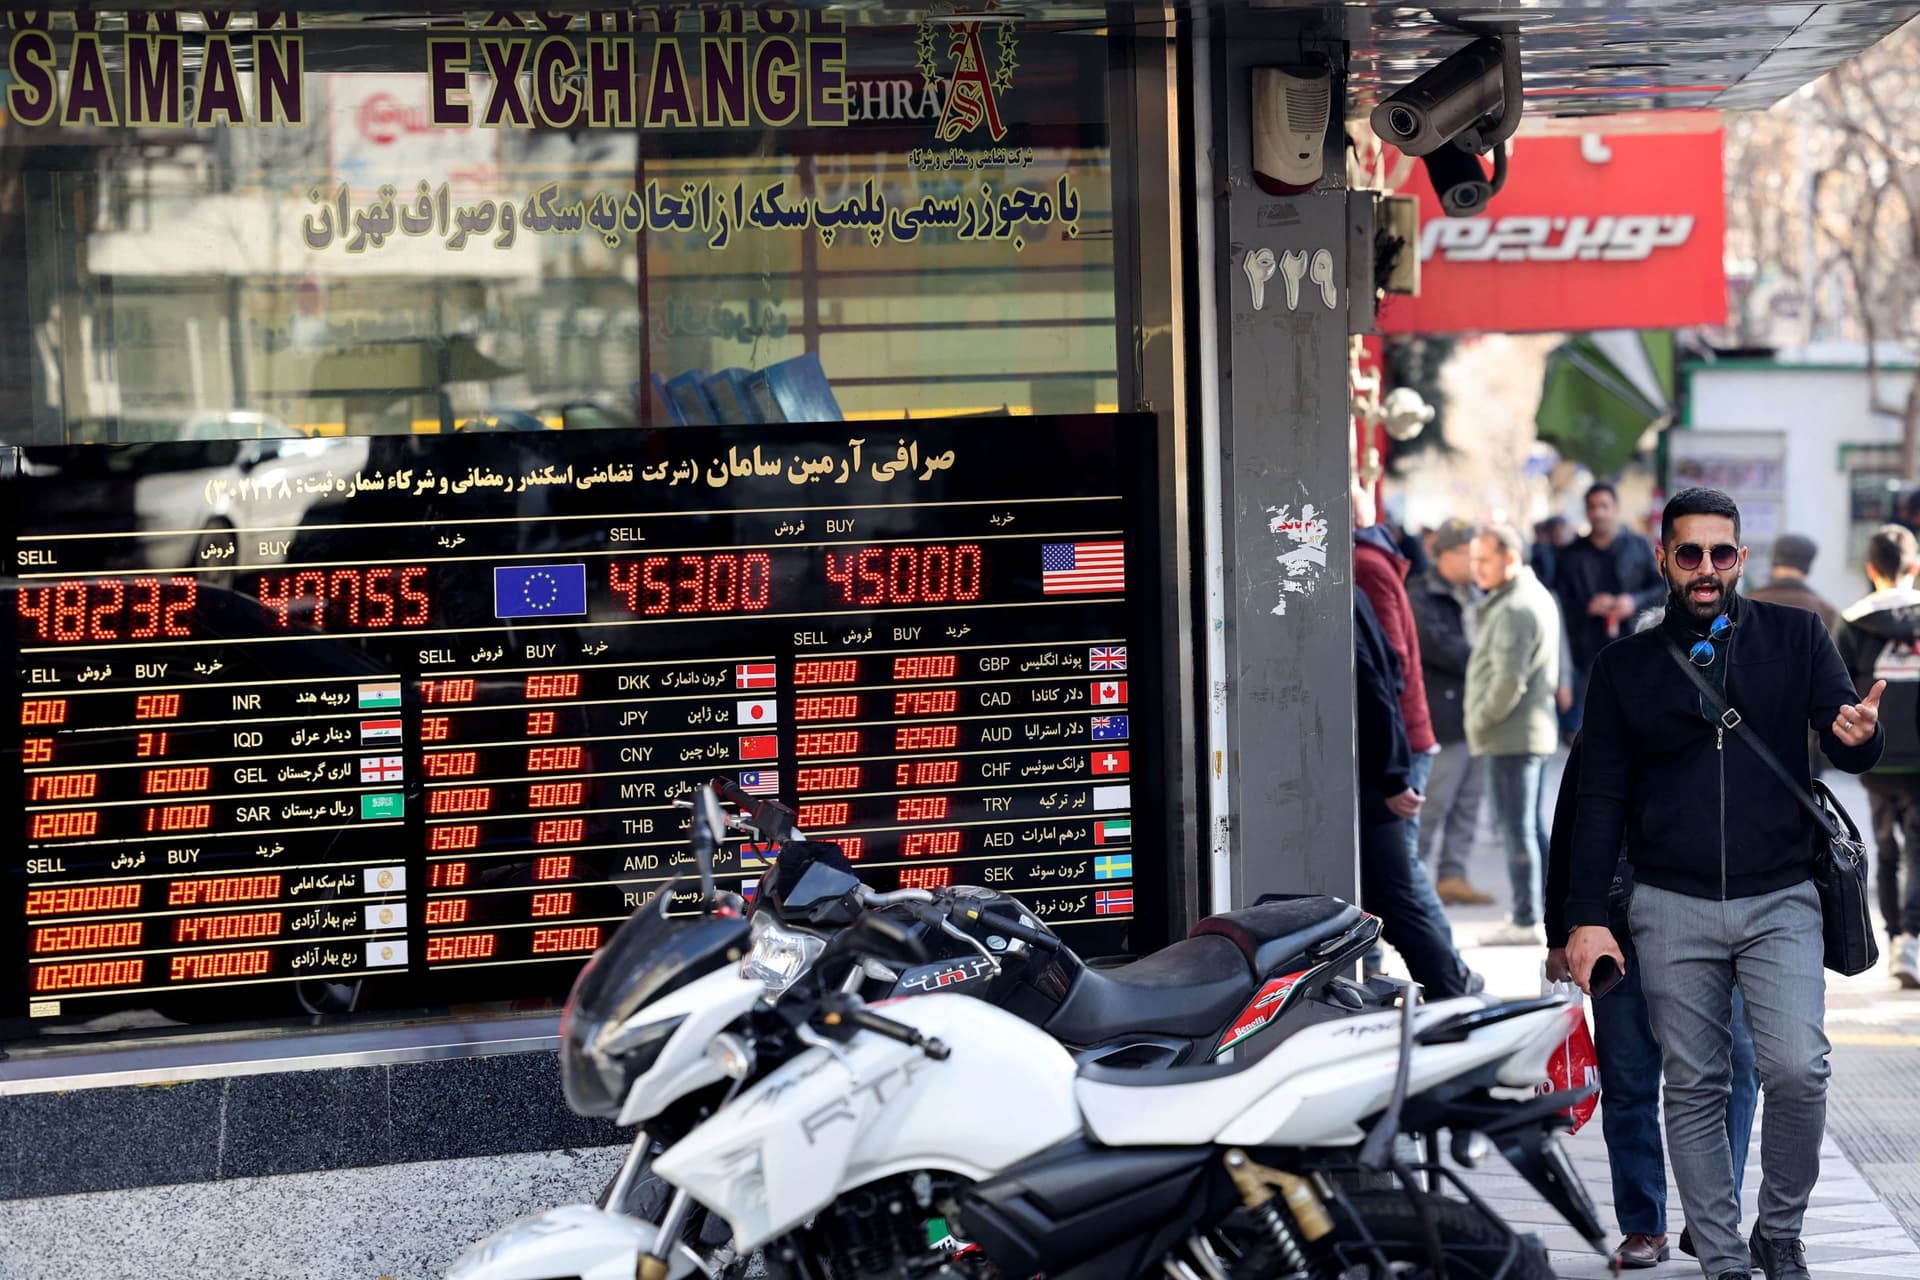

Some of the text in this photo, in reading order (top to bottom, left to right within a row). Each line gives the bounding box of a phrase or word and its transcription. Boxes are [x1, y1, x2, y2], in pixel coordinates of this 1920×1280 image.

[6, 29, 306, 128] SAMAN
[427, 36, 848, 128] EXCHANGE
[520, 180, 585, 235] سکه
[749, 180, 810, 231] سکه
[813, 176, 887, 248] پلمپ
[1056, 171, 1081, 241] با
[302, 181, 397, 254] تهران
[888, 194, 976, 241] رسمی
[975, 183, 1053, 252] مجوز
[1243, 248, 1338, 311] ۴۲۹
[706, 445, 781, 488] سامان
[788, 438, 865, 485] آرمین
[872, 438, 955, 482] صرافی
[337, 471, 384, 498] شماره
[389, 468, 436, 495] شرکاء
[451, 467, 514, 494] رمضانی
[516, 464, 573, 492] اسکندر
[576, 463, 634, 490] تضامنی
[775, 520, 804, 536] فروش
[827, 520, 854, 532] BUY
[990, 515, 1014, 526] خرید
[438, 534, 465, 548] خرید
[611, 528, 645, 541] SELL
[18, 551, 57, 565] SELL
[201, 542, 234, 559] فروش
[259, 541, 291, 556] BUY
[609, 552, 769, 613] 45300
[827, 546, 980, 604] 45000
[18, 576, 196, 640] 48232
[260, 568, 428, 626] 47755
[794, 632, 827, 645] SELL
[843, 628, 872, 644] فروش
[894, 627, 921, 640] BUY
[946, 624, 970, 637] خرید
[419, 650, 455, 664] SELL
[472, 646, 502, 662] فروش
[527, 644, 556, 658] BUY
[582, 641, 608, 655] خرید
[136, 664, 167, 678] BUY
[194, 660, 222, 674] خرید
[794, 661, 856, 684] 59000
[894, 656, 955, 679] 58000
[980, 657, 1009, 671] GBP
[1020, 652, 1082, 672] پوند انگلیس
[78, 665, 111, 682] فروش
[619, 675, 650, 690] DKK
[661, 669, 728, 688] کرون دانمارک
[421, 680, 473, 702] 7100
[526, 675, 578, 697] 6600
[1032, 687, 1083, 703] دلار کانادا
[136, 695, 179, 718] 500
[233, 695, 261, 710] INR
[296, 690, 351, 706] روپیه هند
[795, 696, 857, 719] 38500
[895, 691, 956, 714] 37500
[981, 692, 1010, 706] CAD
[22, 700, 65, 724] 600
[528, 712, 554, 734] 33
[620, 711, 648, 725] JPY
[687, 706, 729, 724] ین ژاپن
[234, 732, 262, 747] IQD
[291, 727, 352, 746] دینار عراق
[421, 718, 448, 740] 36
[896, 726, 957, 749] 32500
[981, 727, 1011, 742] AUD
[1025, 721, 1084, 740] دلار استرالیا
[23, 739, 52, 762] 35
[138, 733, 166, 756] 31
[621, 747, 652, 761] CNY
[680, 742, 729, 761] یوان چین
[796, 732, 858, 755] 33500
[424, 753, 475, 776] 7500
[528, 747, 580, 770] 6500
[1057, 756, 1085, 773] فرانک
[147, 768, 208, 793] 16000
[234, 768, 267, 783] GEL
[328, 762, 352, 780] لاری
[797, 767, 859, 790] 52000
[897, 762, 958, 784] 51000
[982, 763, 1011, 777] CHF
[32, 774, 96, 800] 17000
[529, 783, 582, 807] 9000
[622, 784, 655, 798] MYR
[664, 780, 692, 798] مالزی
[281, 800, 354, 820] ریال عربستان
[431, 789, 489, 813] 10000
[897, 798, 946, 820] 2500
[983, 797, 1011, 811] TRY
[1040, 793, 1068, 809] ترکیه
[33, 812, 97, 838] 12000
[148, 805, 210, 830] 11000
[237, 807, 270, 822] SAR
[798, 804, 848, 826] 2800
[432, 826, 477, 849] 1500
[538, 820, 582, 843] 1200
[622, 819, 653, 834] THB
[1022, 826, 1086, 846] درهم امارات
[256, 843, 284, 857] خرید
[905, 832, 959, 855] 12700
[984, 833, 1013, 847] AED
[27, 859, 66, 873] SELL
[112, 852, 145, 869] فروش
[168, 849, 200, 864] BUY
[624, 855, 658, 870] AMD
[712, 848, 733, 868] درام
[433, 864, 465, 886] 118
[539, 857, 570, 879] 108
[985, 867, 1013, 881] SEK
[1058, 861, 1087, 878] کرون
[315, 874, 337, 888] سکه
[337, 872, 356, 895] تمام
[26, 884, 140, 914] 29300000
[532, 893, 571, 916] 500
[1059, 895, 1088, 912] کرون
[291, 909, 357, 931] نیم بهار آزادی
[426, 900, 466, 923] 600
[427, 935, 493, 960] 26000
[533, 928, 600, 953] 25000
[291, 947, 358, 968] ربع بهار آزادی
[1234, 1015, 1267, 1037] Benelli
